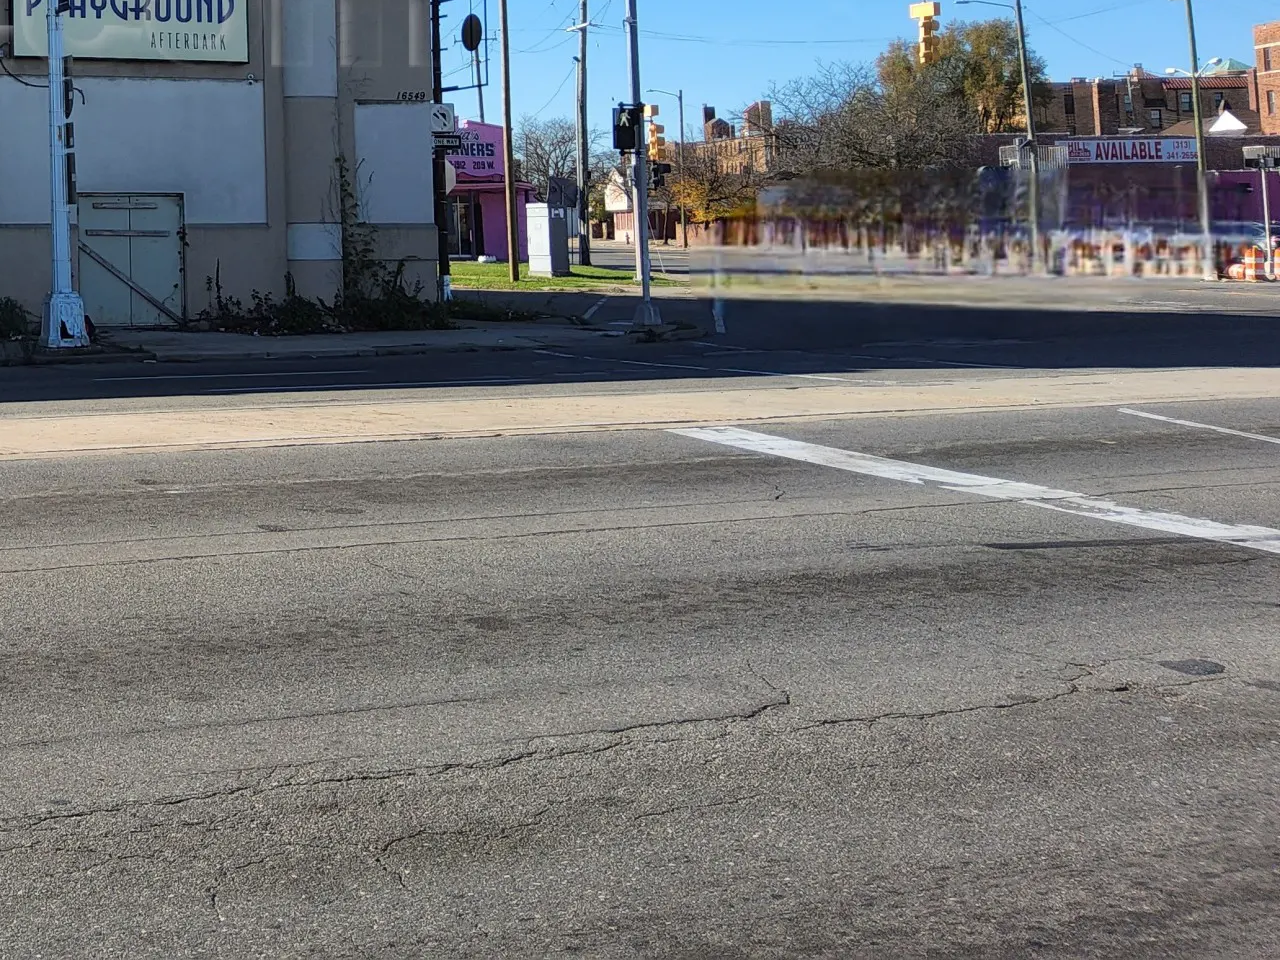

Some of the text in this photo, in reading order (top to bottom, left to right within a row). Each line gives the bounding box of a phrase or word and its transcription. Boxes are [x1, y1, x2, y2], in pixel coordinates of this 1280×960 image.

[150, 31, 227, 52] AFTERDARK
[396, 91, 426, 100] 16549
[1094, 141, 1162, 161] AVAILABLE
[1172, 140, 1191, 150] (313)
